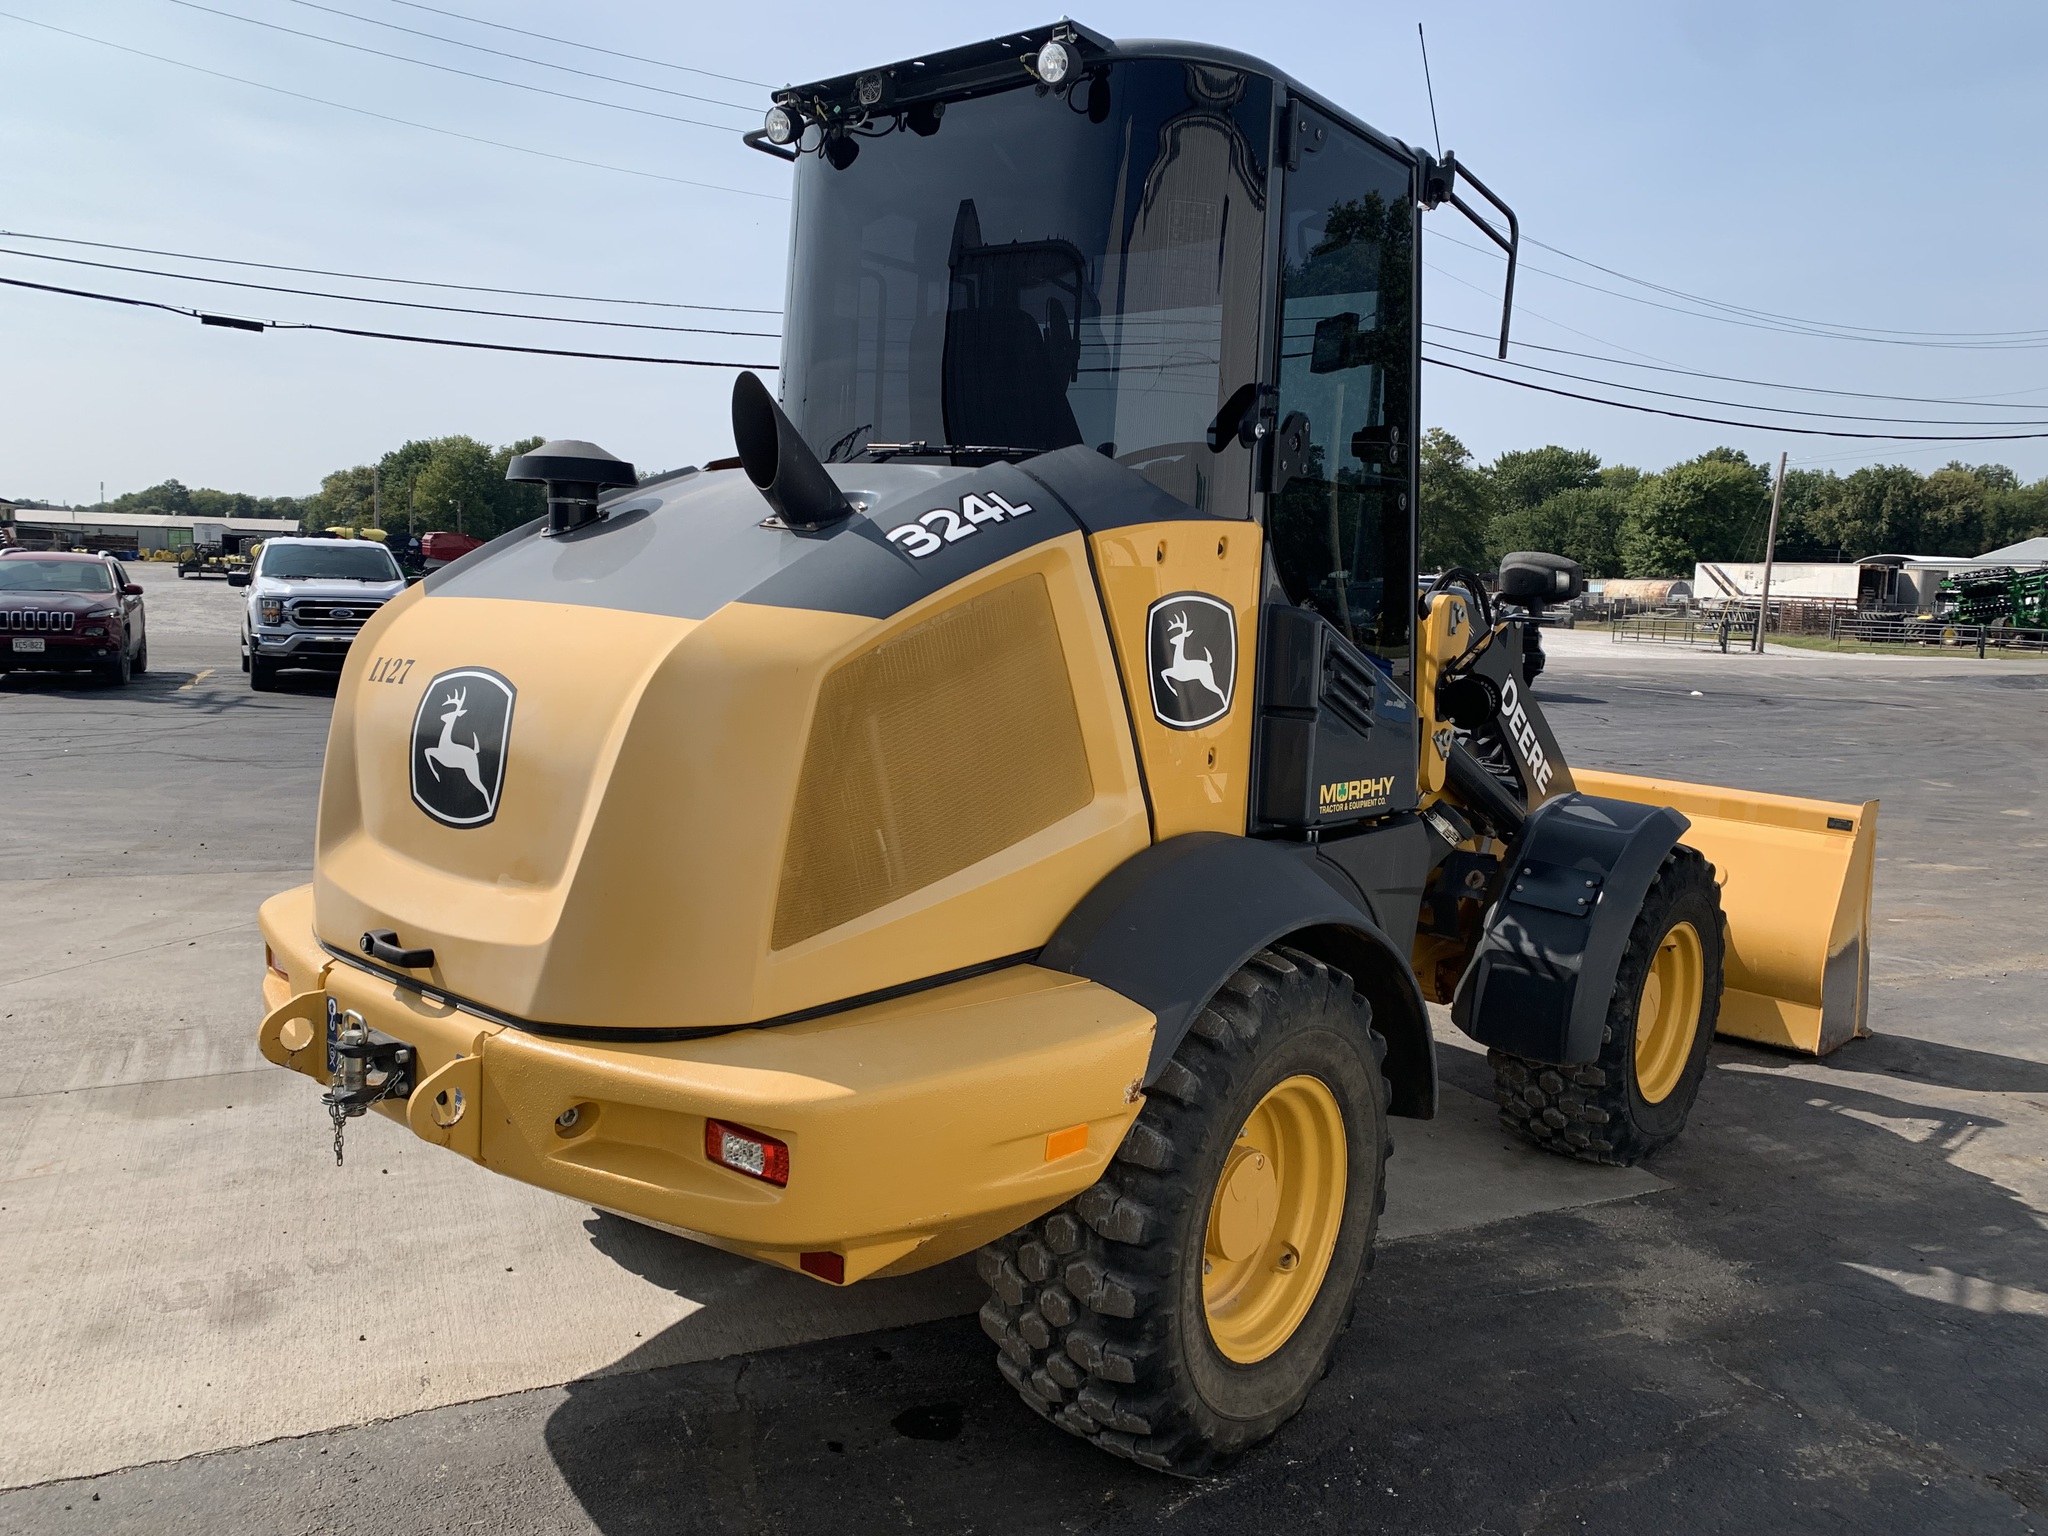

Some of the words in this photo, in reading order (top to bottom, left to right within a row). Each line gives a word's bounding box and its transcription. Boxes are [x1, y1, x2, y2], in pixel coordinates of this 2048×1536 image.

[885, 493, 1033, 557] 324L
[1501, 673, 1553, 796] DEERE
[1319, 776, 1395, 804] MURPHY
[1319, 803, 1344, 814] TRACTOR
[1344, 803, 1348, 811] &
[1349, 799, 1377, 810] EQUIPMENT
[1377, 797, 1386, 805] CO.
